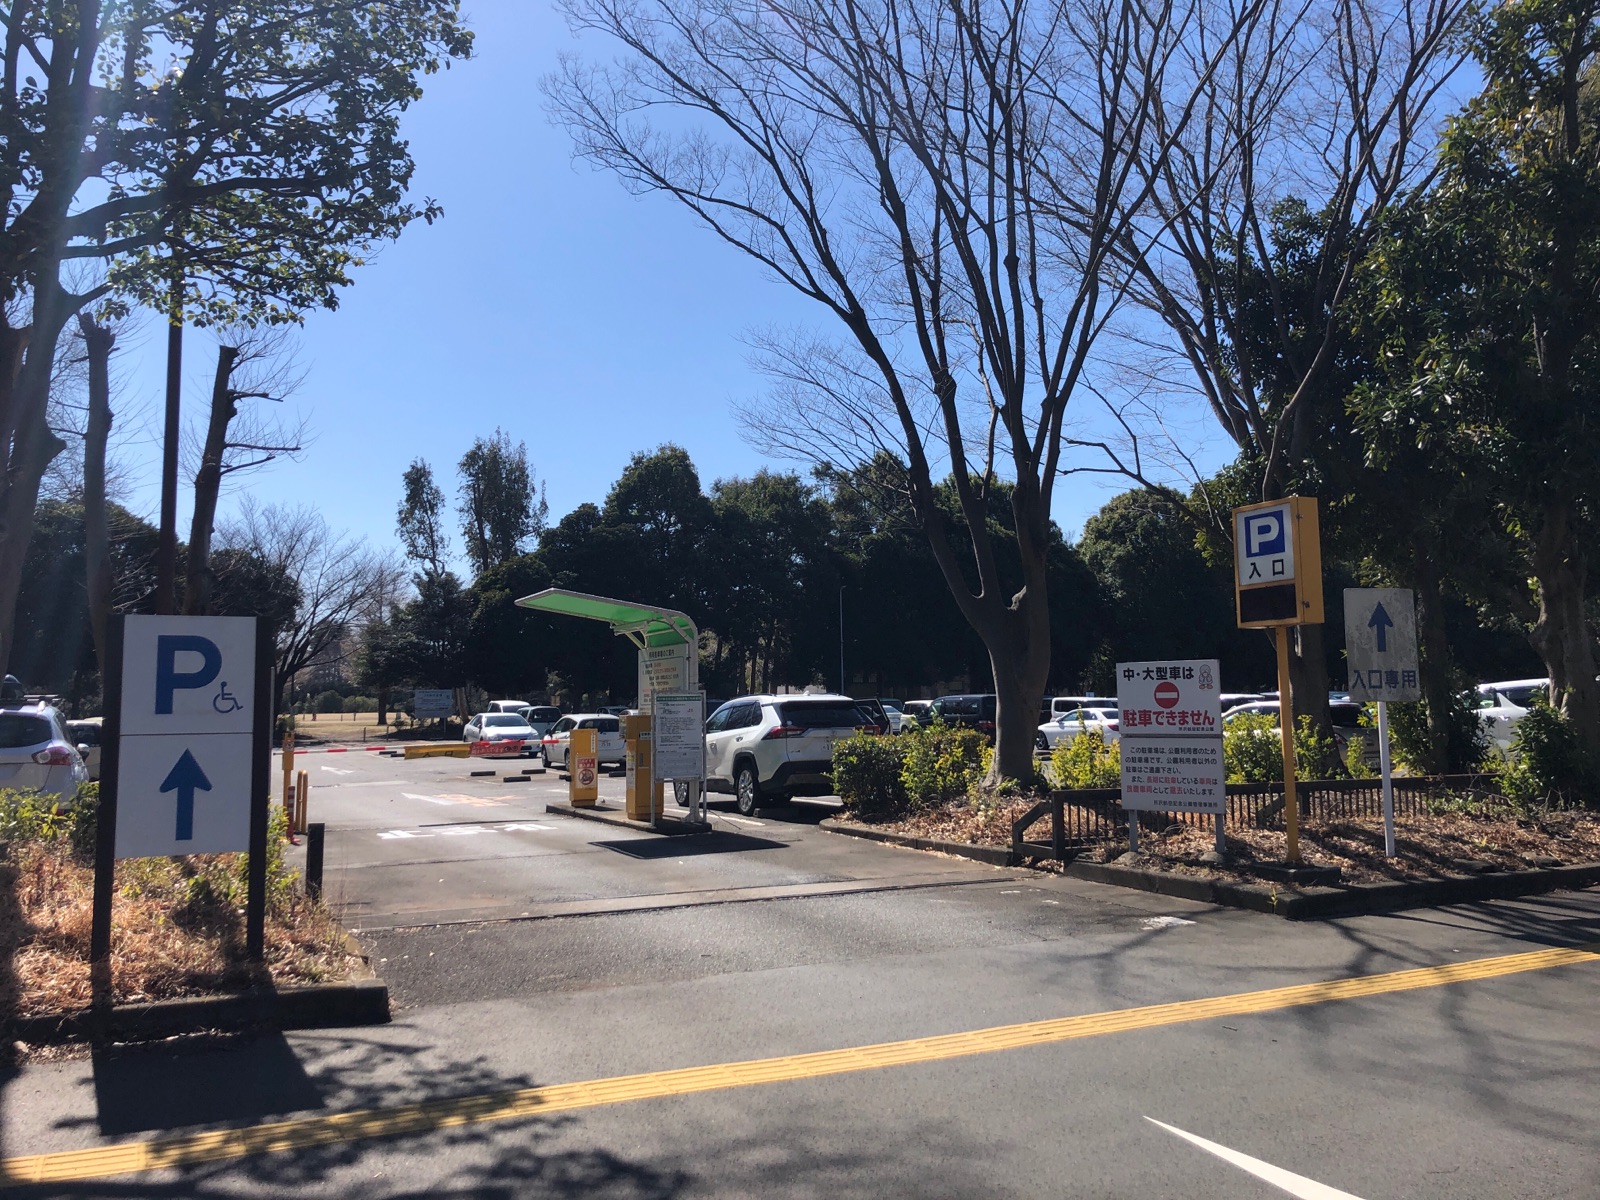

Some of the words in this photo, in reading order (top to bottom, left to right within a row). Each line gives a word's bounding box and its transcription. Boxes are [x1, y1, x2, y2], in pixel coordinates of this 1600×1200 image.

[1249, 515, 1280, 554] P
[1248, 558, 1285, 580] 入口
[155, 634, 222, 715] P
[1123, 665, 1194, 681] 中・大型車は
[1351, 669, 1417, 690] 入口専用
[1123, 709, 1215, 727] 駐車できません
